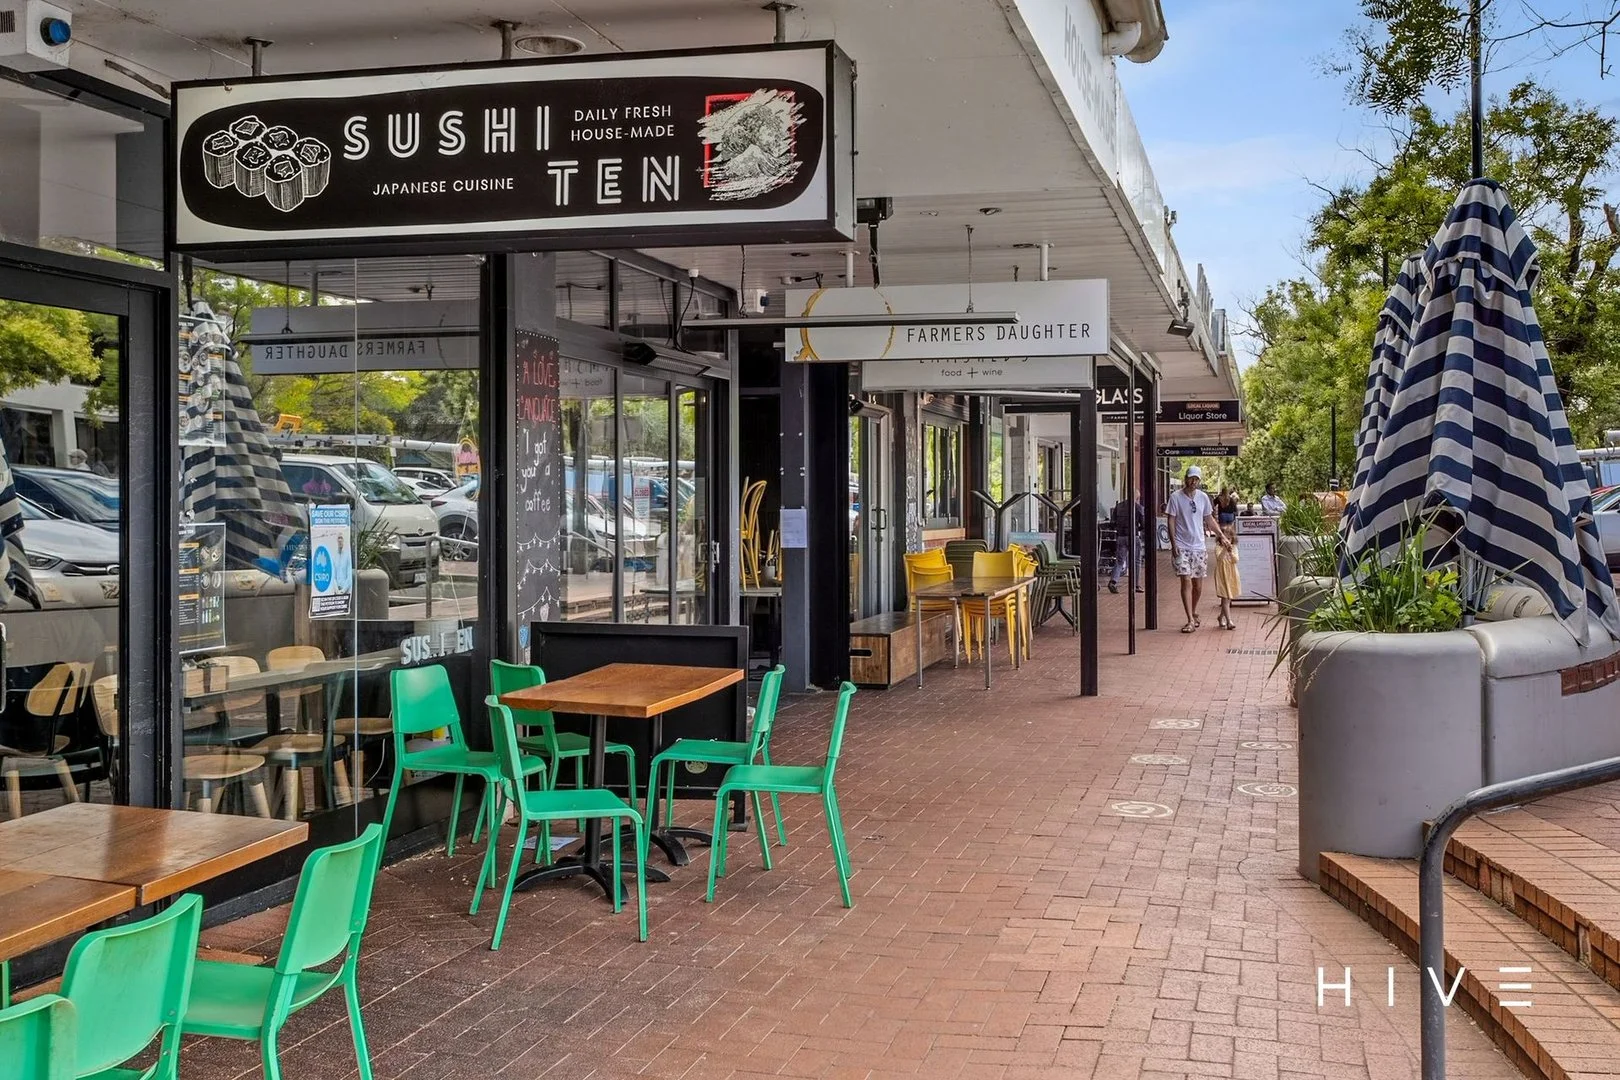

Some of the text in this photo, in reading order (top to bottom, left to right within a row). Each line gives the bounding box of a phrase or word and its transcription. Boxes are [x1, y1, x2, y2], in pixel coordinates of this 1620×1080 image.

[574, 104, 672, 121] DAILY FRESH
[342, 105, 550, 161] SUSHI
[570, 124, 675, 142] HOUSE-MADE
[372, 177, 514, 196] JAPANESE CUISINE
[547, 155, 681, 206] TEN
[907, 323, 1091, 343] FARMERS DAUGHTER
[941, 368, 962, 377] food
[982, 367, 1003, 376] wine
[1179, 411, 1228, 420] Liquor Store
[520, 465, 536, 494] you
[314, 573, 330, 582] CSIRO
